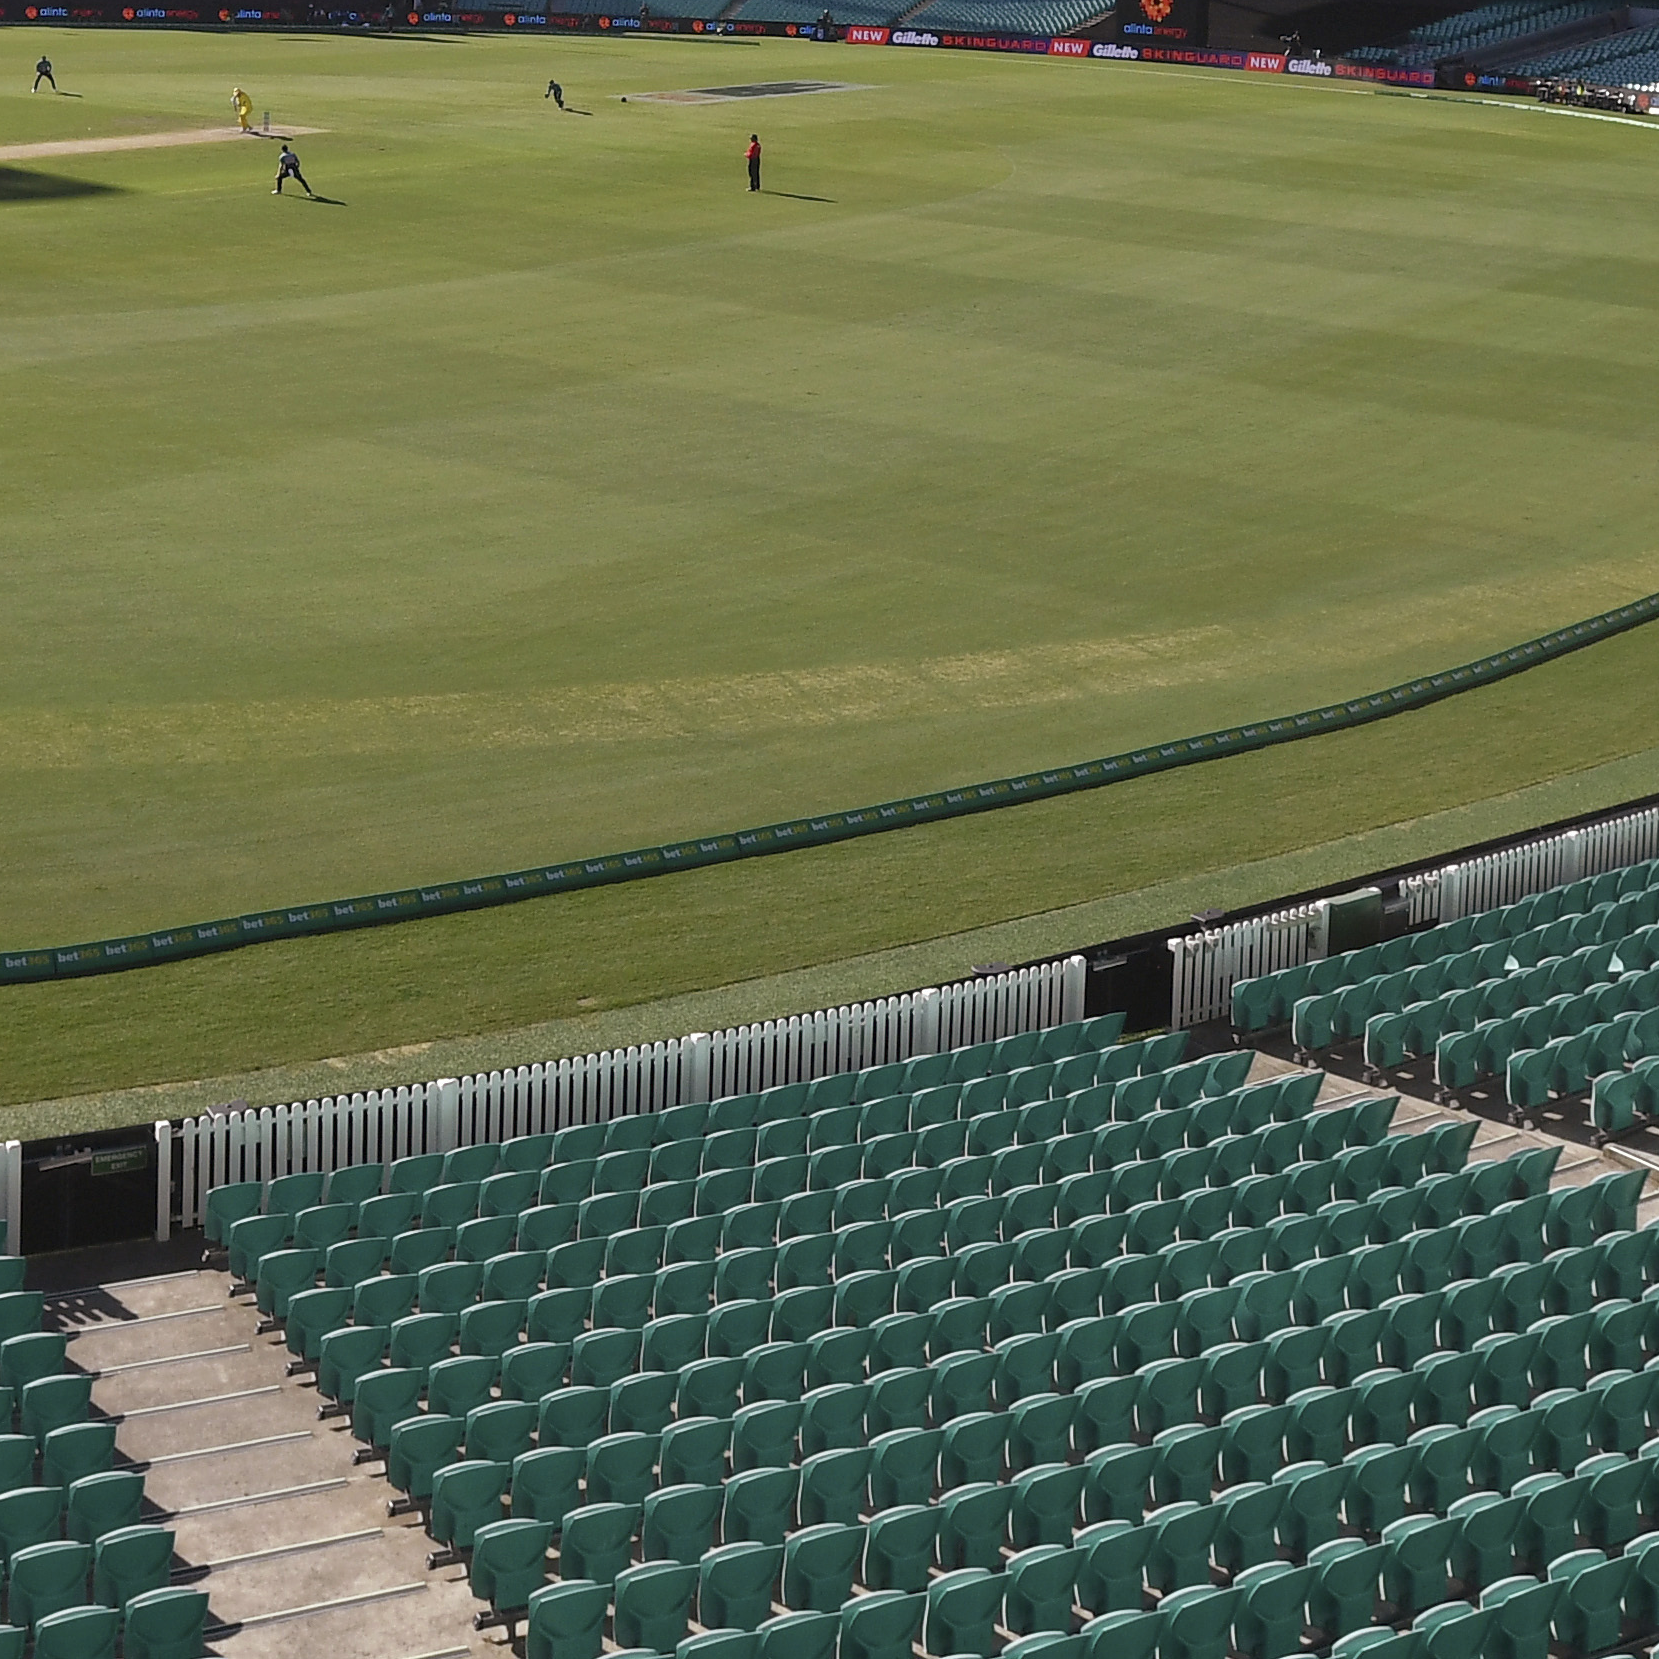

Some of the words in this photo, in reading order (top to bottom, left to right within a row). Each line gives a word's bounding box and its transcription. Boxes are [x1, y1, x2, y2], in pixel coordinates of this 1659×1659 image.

[851, 30, 883, 42] NEW
[892, 31, 939, 46] Gillette
[1053, 42, 1084, 55] NEW
[1092, 43, 1139, 60] Gillette
[1250, 56, 1280, 70] NEW
[1288, 59, 1332, 77] Gillette
